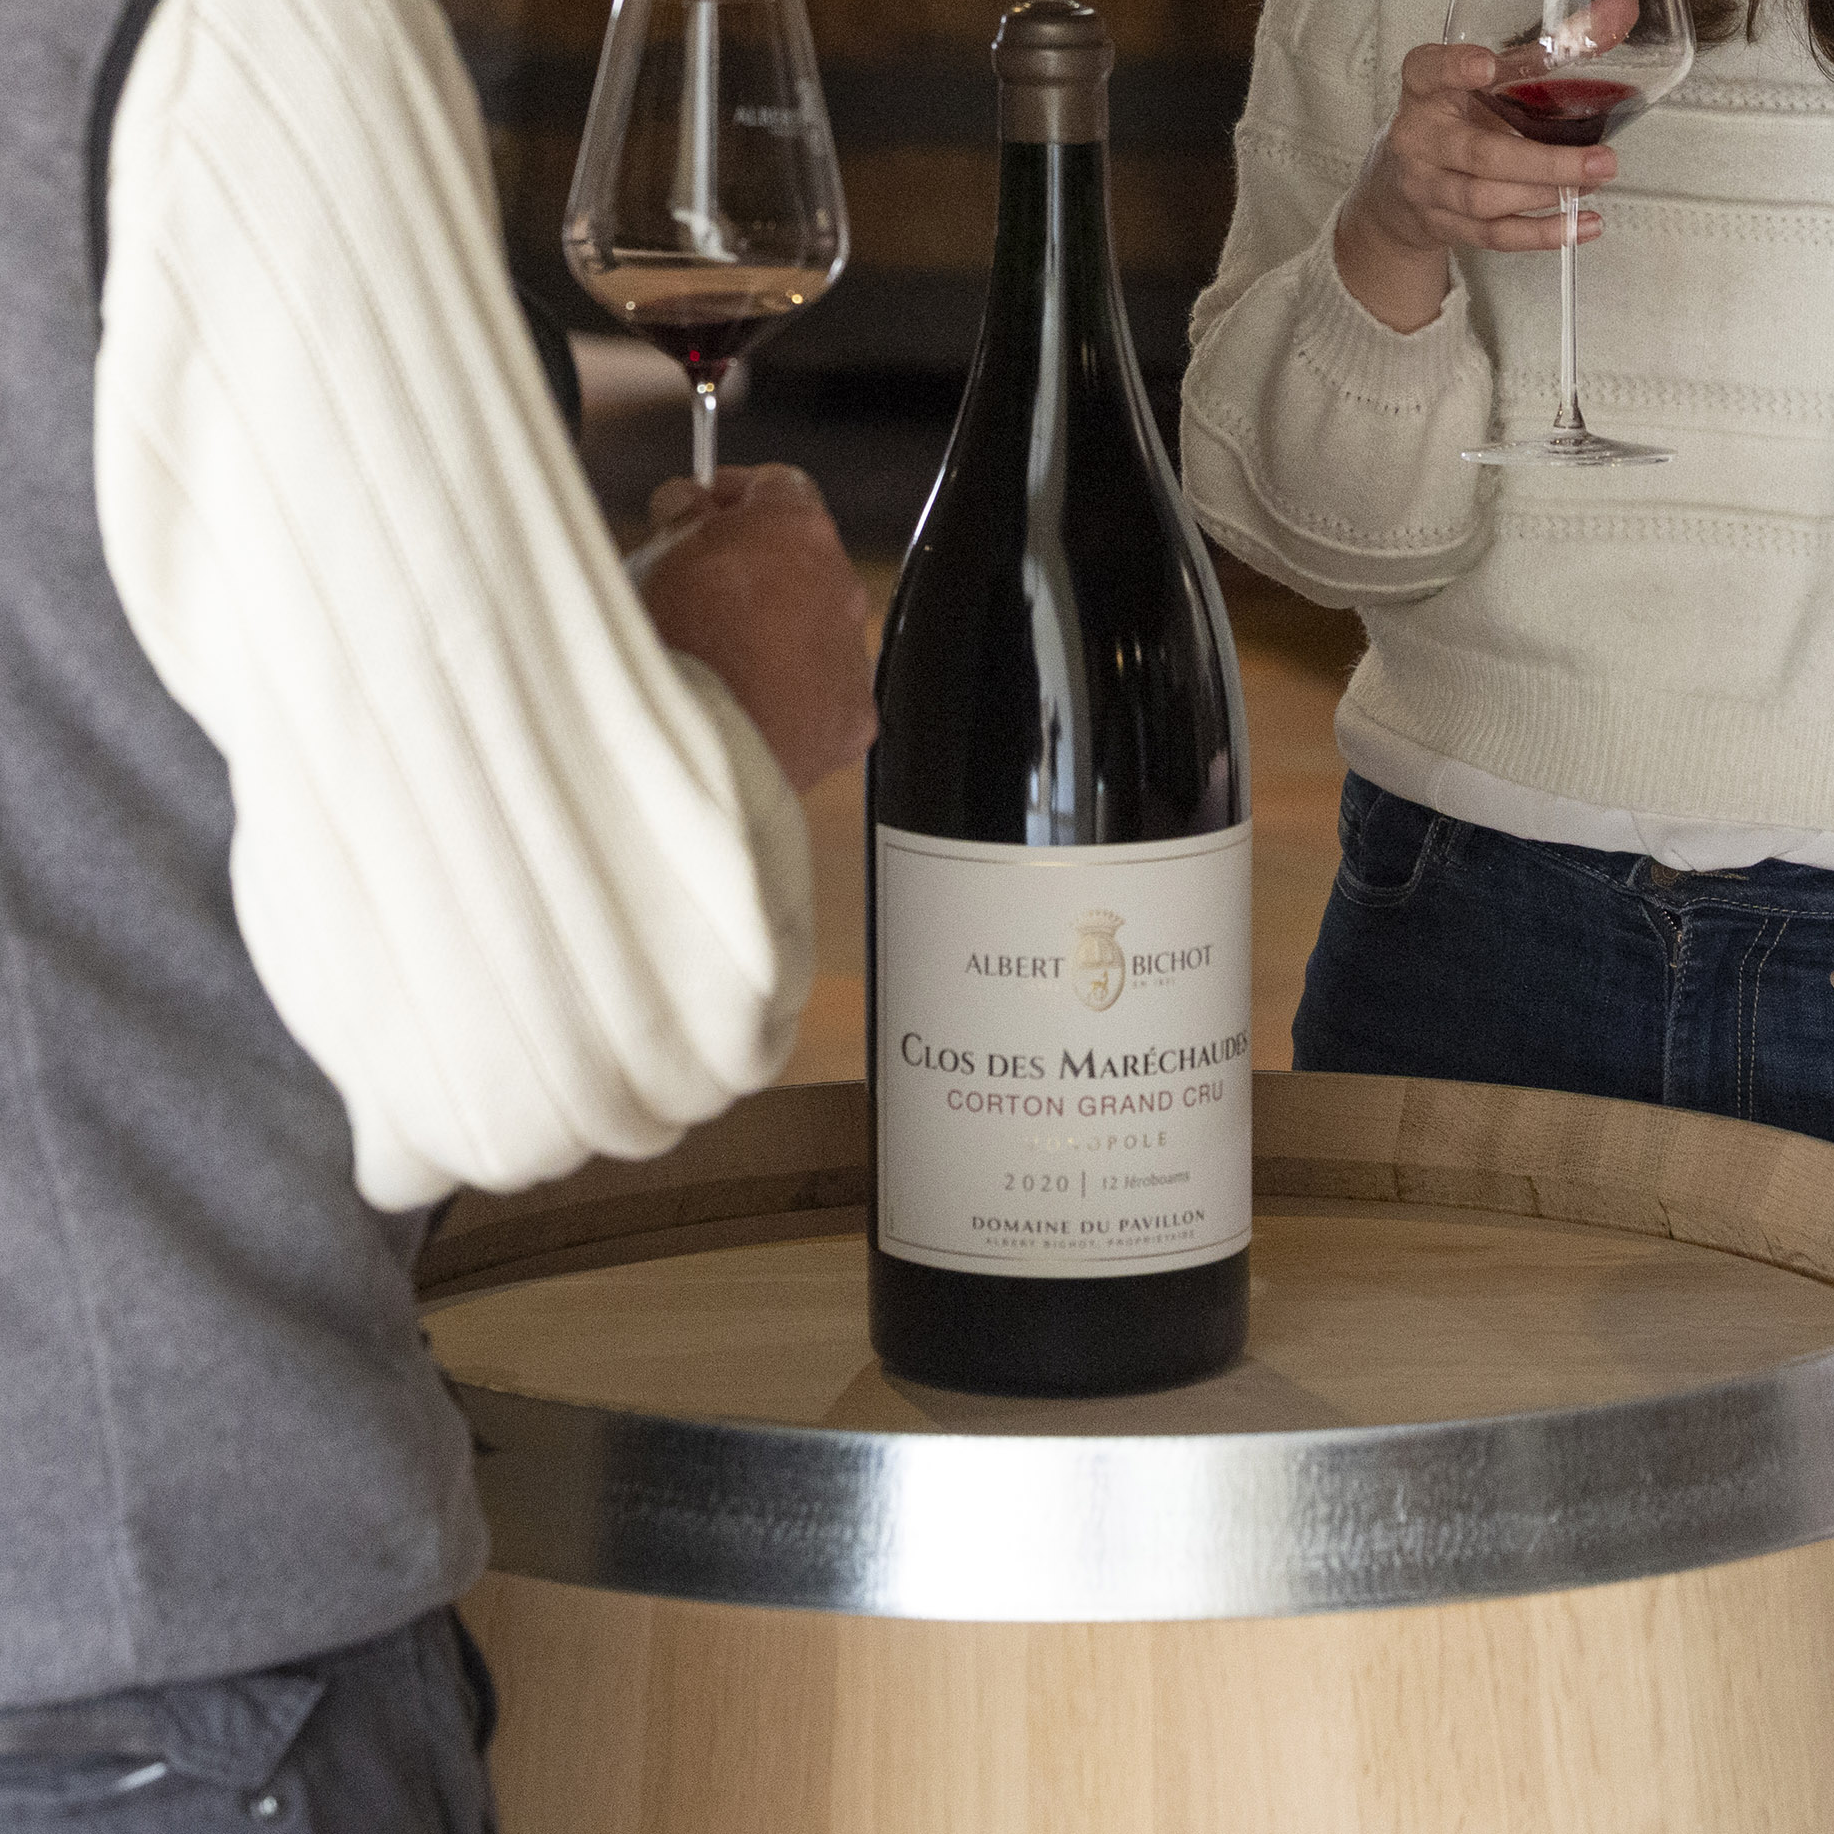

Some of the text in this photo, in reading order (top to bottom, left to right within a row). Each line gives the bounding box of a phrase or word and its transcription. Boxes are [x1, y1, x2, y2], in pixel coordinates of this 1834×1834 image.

[964, 944, 1214, 980] ALBERT BICHOT
[900, 1031, 976, 1075] CLOS
[987, 1052, 1046, 1081] DES
[946, 1078, 1225, 1118] CORTON GRAND CRU
[1004, 1171, 1069, 1193] 2020
[971, 1209, 1205, 1235] DOMAINE DU PAVILLON
